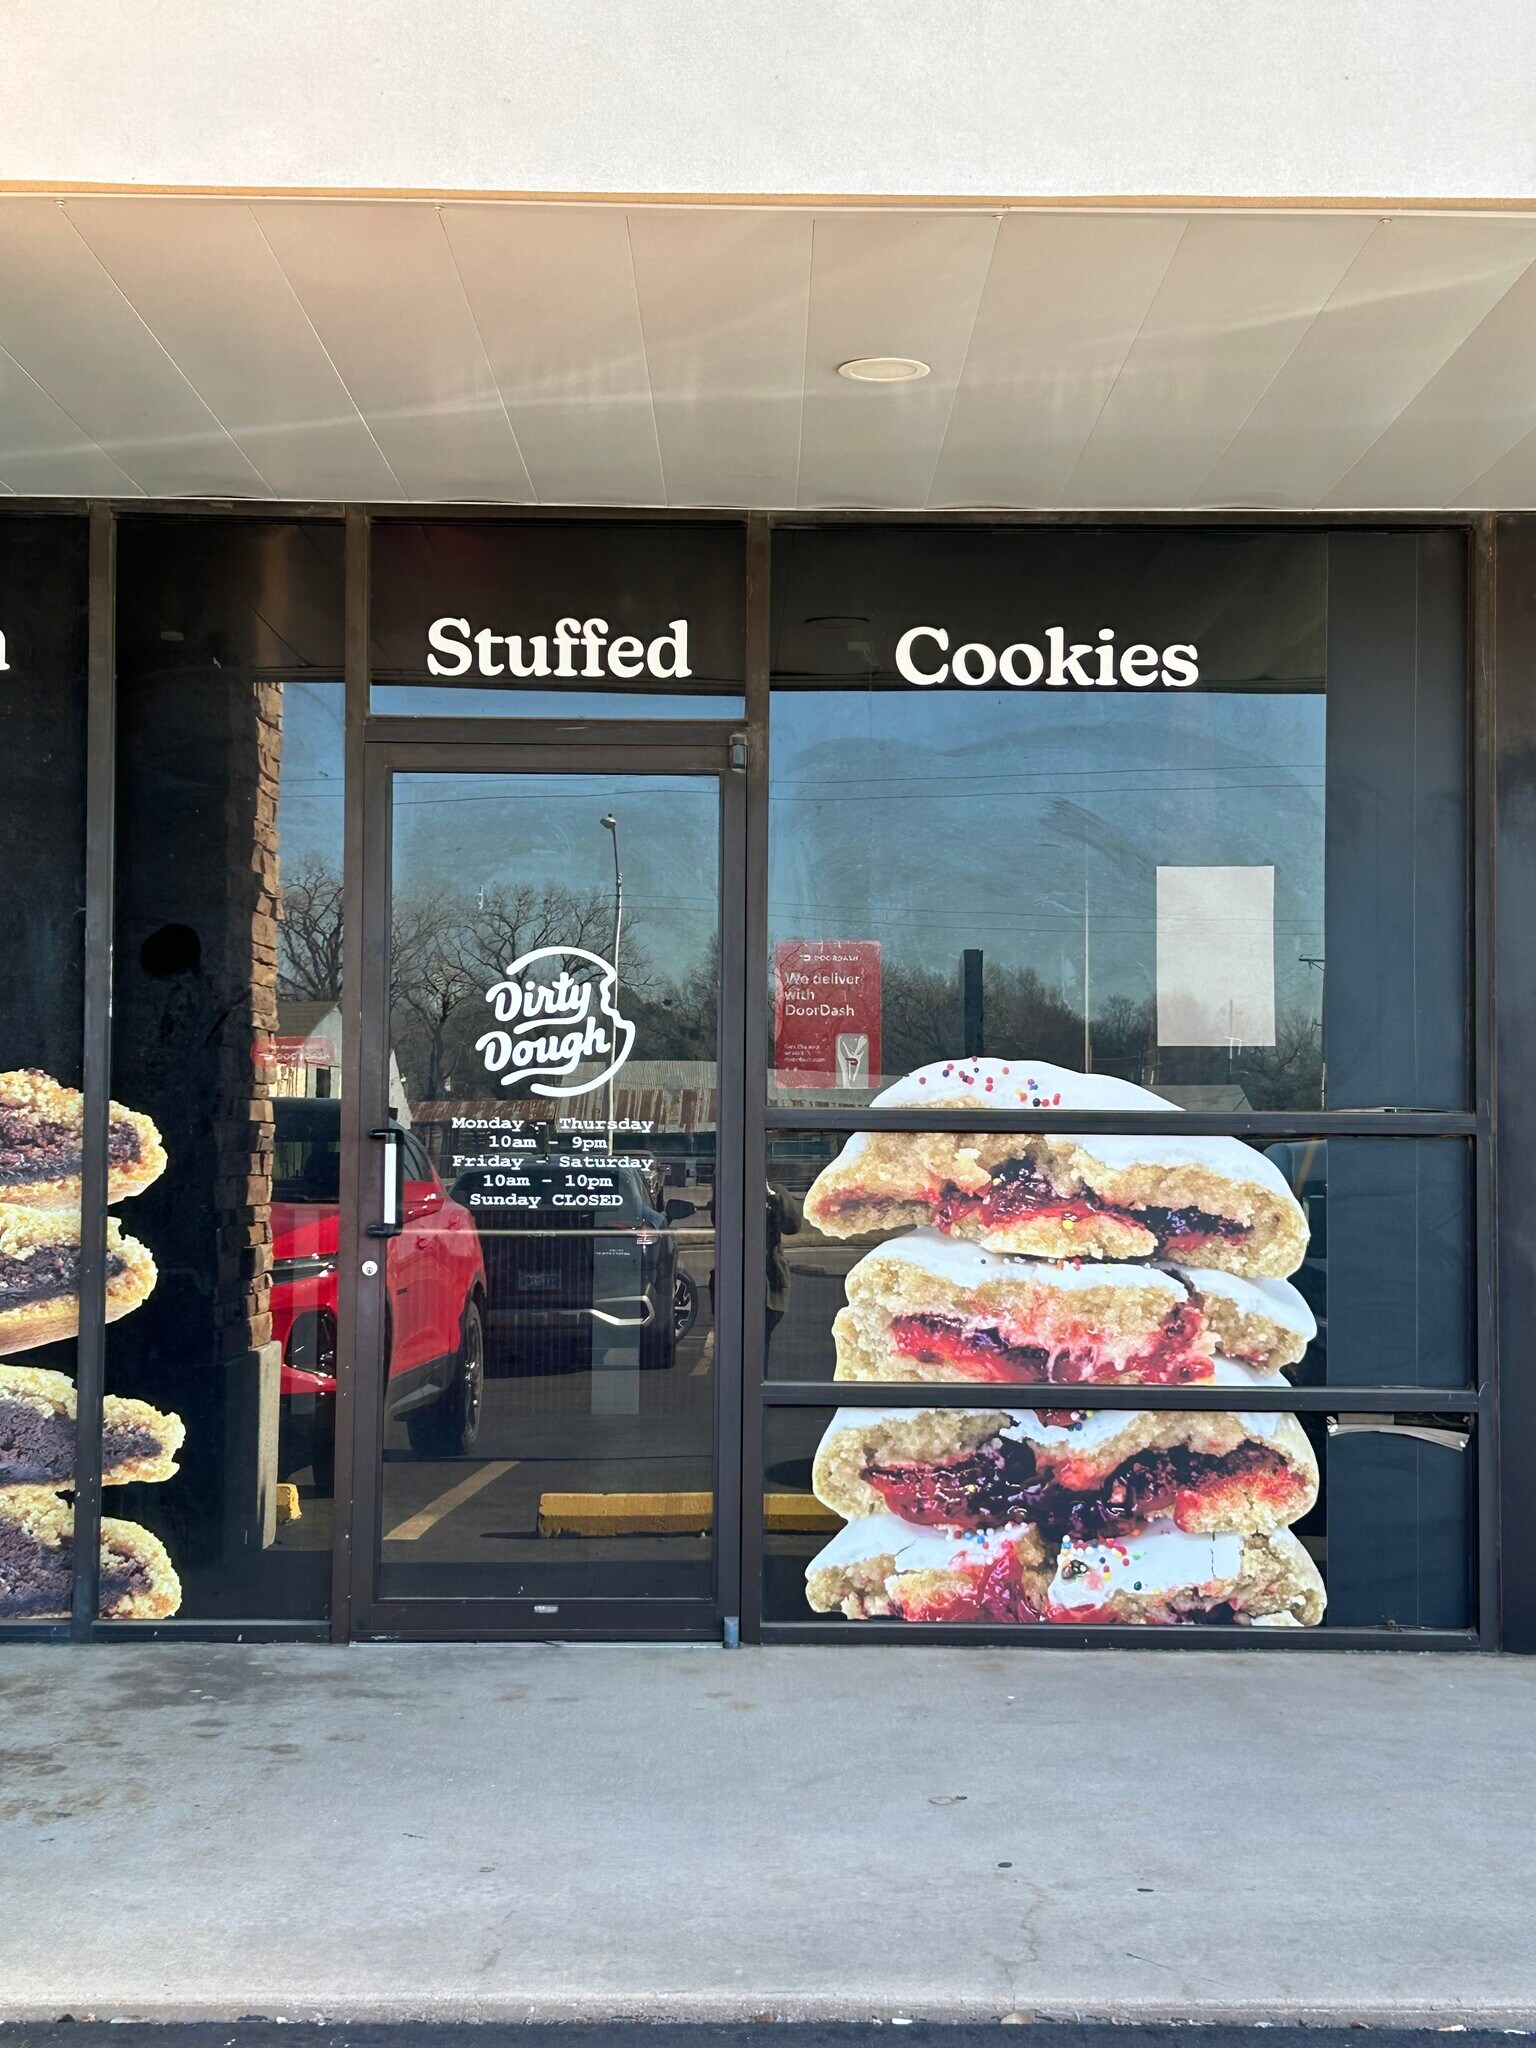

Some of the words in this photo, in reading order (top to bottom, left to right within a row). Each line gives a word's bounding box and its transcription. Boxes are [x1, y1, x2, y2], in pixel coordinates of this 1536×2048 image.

[428, 618, 692, 679] Stuffed
[896, 627, 1198, 687] Cookies
[785, 972, 810, 985] We
[812, 972, 860, 985] deliver
[784, 988, 815, 1001] with
[486, 972, 591, 1034] Dirty
[785, 1004, 855, 1017] DoorDash
[475, 1016, 611, 1086] Dough
[451, 1117, 525, 1132] Monday
[559, 1117, 654, 1132] Thursday
[488, 1135, 537, 1148] 10am
[572, 1136, 608, 1152] 9pm
[452, 1155, 525, 1171] Friday
[559, 1156, 654, 1172] Saturday
[483, 1174, 531, 1187] 10am
[565, 1174, 613, 1190] 10pm
[469, 1193, 542, 1209] Sunday
[552, 1193, 624, 1206] CLOSED
